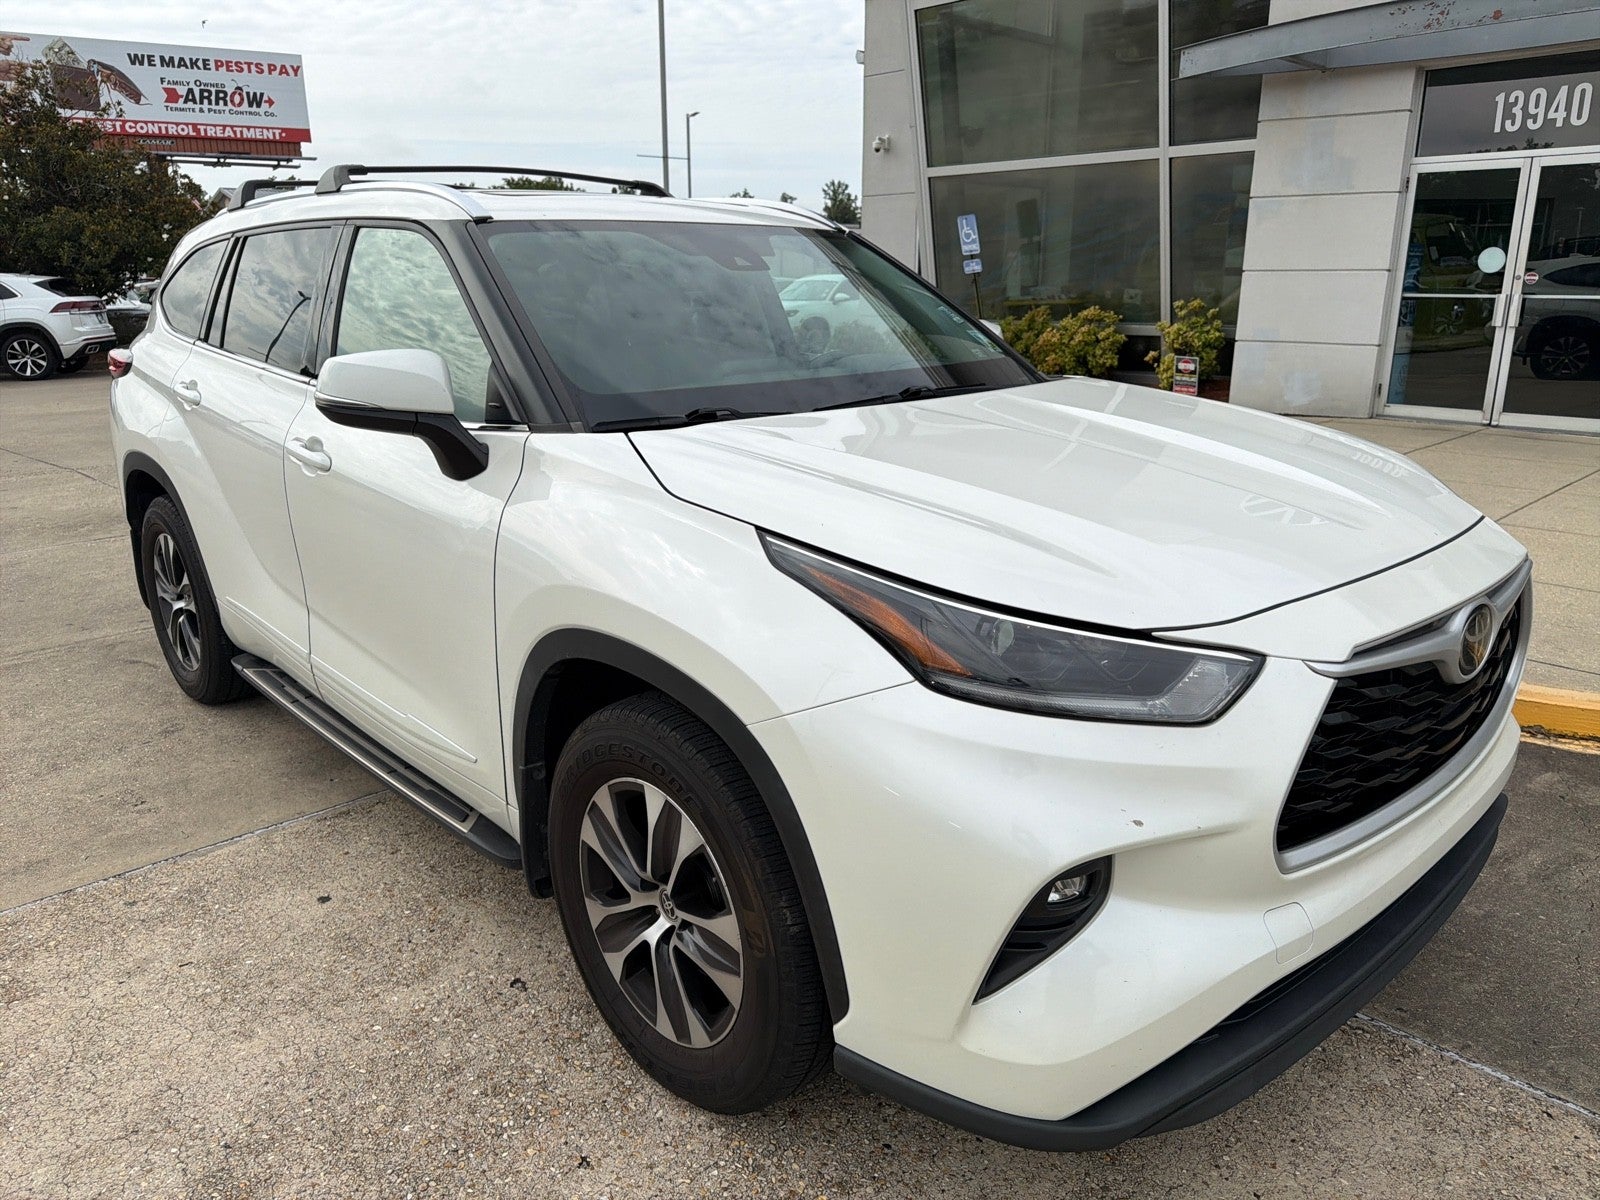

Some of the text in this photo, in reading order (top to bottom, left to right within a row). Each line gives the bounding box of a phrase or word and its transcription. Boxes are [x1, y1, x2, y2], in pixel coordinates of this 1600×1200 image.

[127, 53, 302, 77] WE MAKE PESTS PAY
[183, 87, 265, 109] ARROW
[1493, 82, 1594, 133] 13940
[198, 106, 205, 114] &
[96, 120, 123, 133] EST
[125, 121, 196, 136] CONTROL
